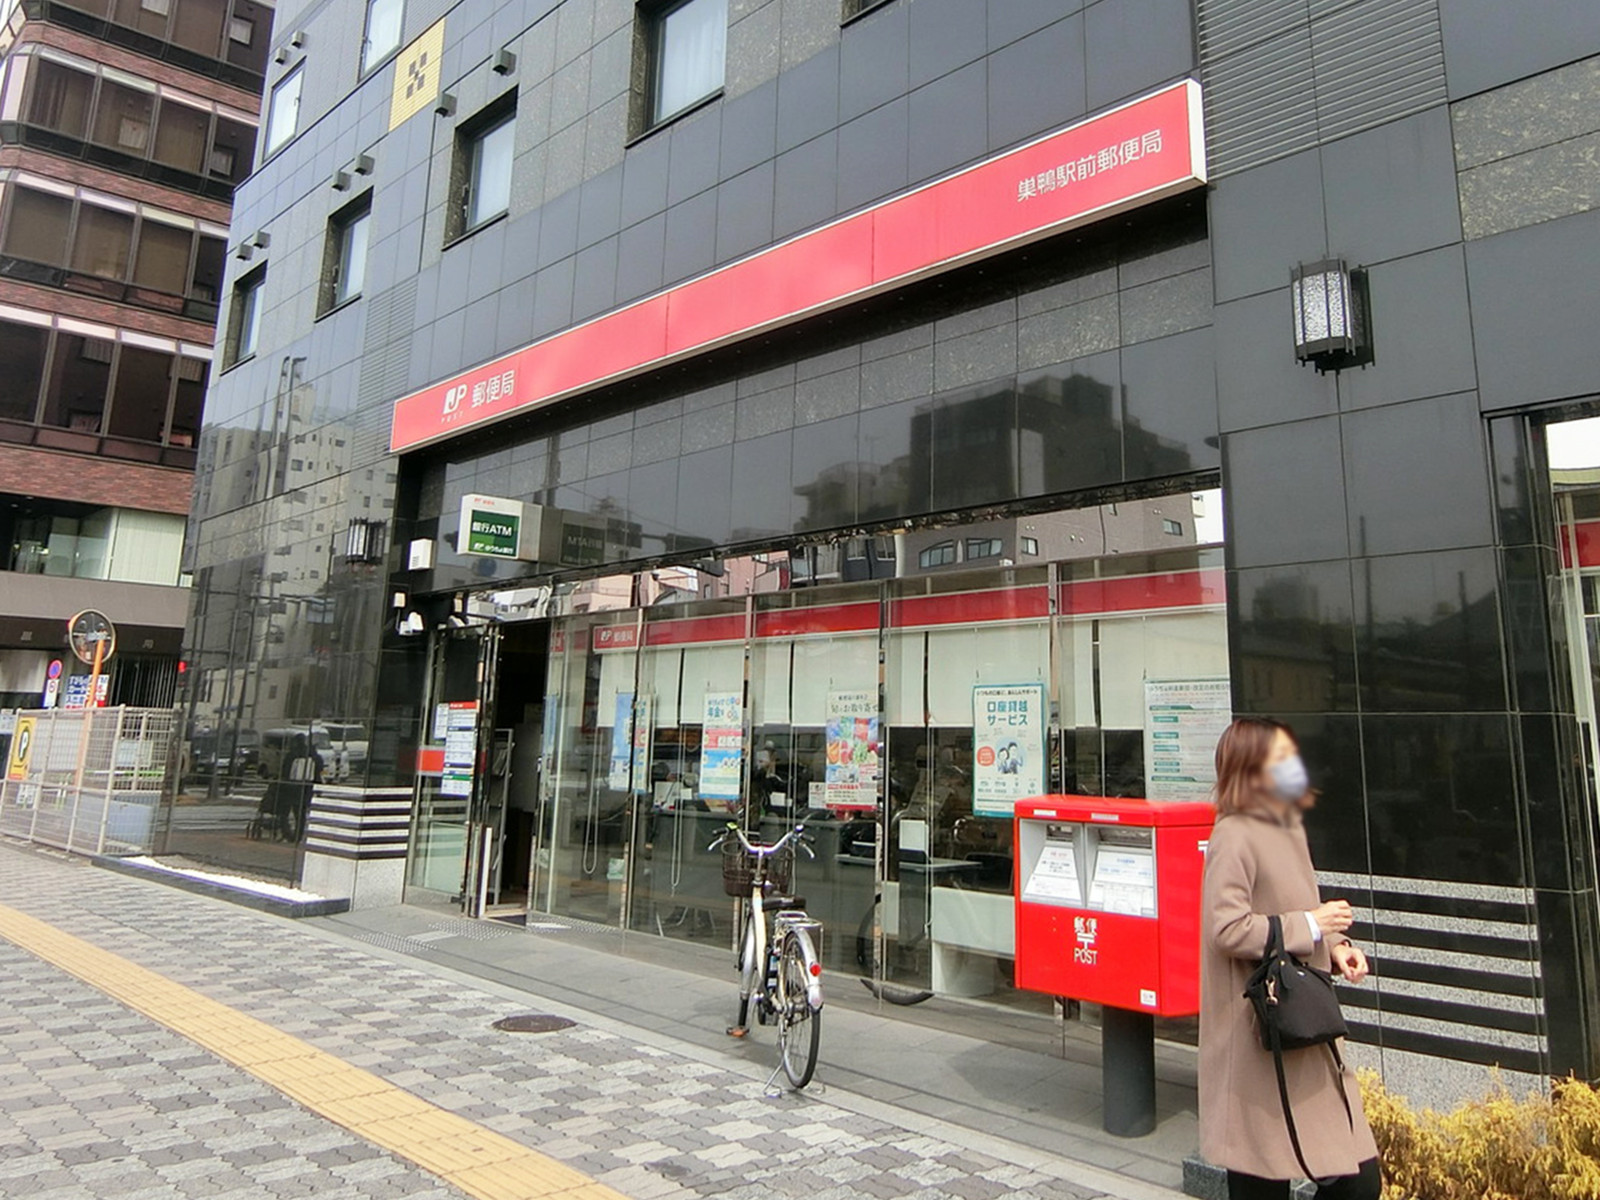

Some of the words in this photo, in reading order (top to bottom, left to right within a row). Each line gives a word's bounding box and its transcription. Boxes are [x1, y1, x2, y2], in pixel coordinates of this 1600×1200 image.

[1017, 129, 1162, 202] 巣鴨駅前郵便局
[471, 370, 515, 408] 郵便局
[472, 521, 512, 537] 銀行ATM
[987, 700, 1028, 712] 口座貸越
[987, 714, 1028, 726] サービス
[20, 731, 29, 759] P
[1074, 917, 1098, 936] 郵便
[1074, 948, 1098, 965] POST
